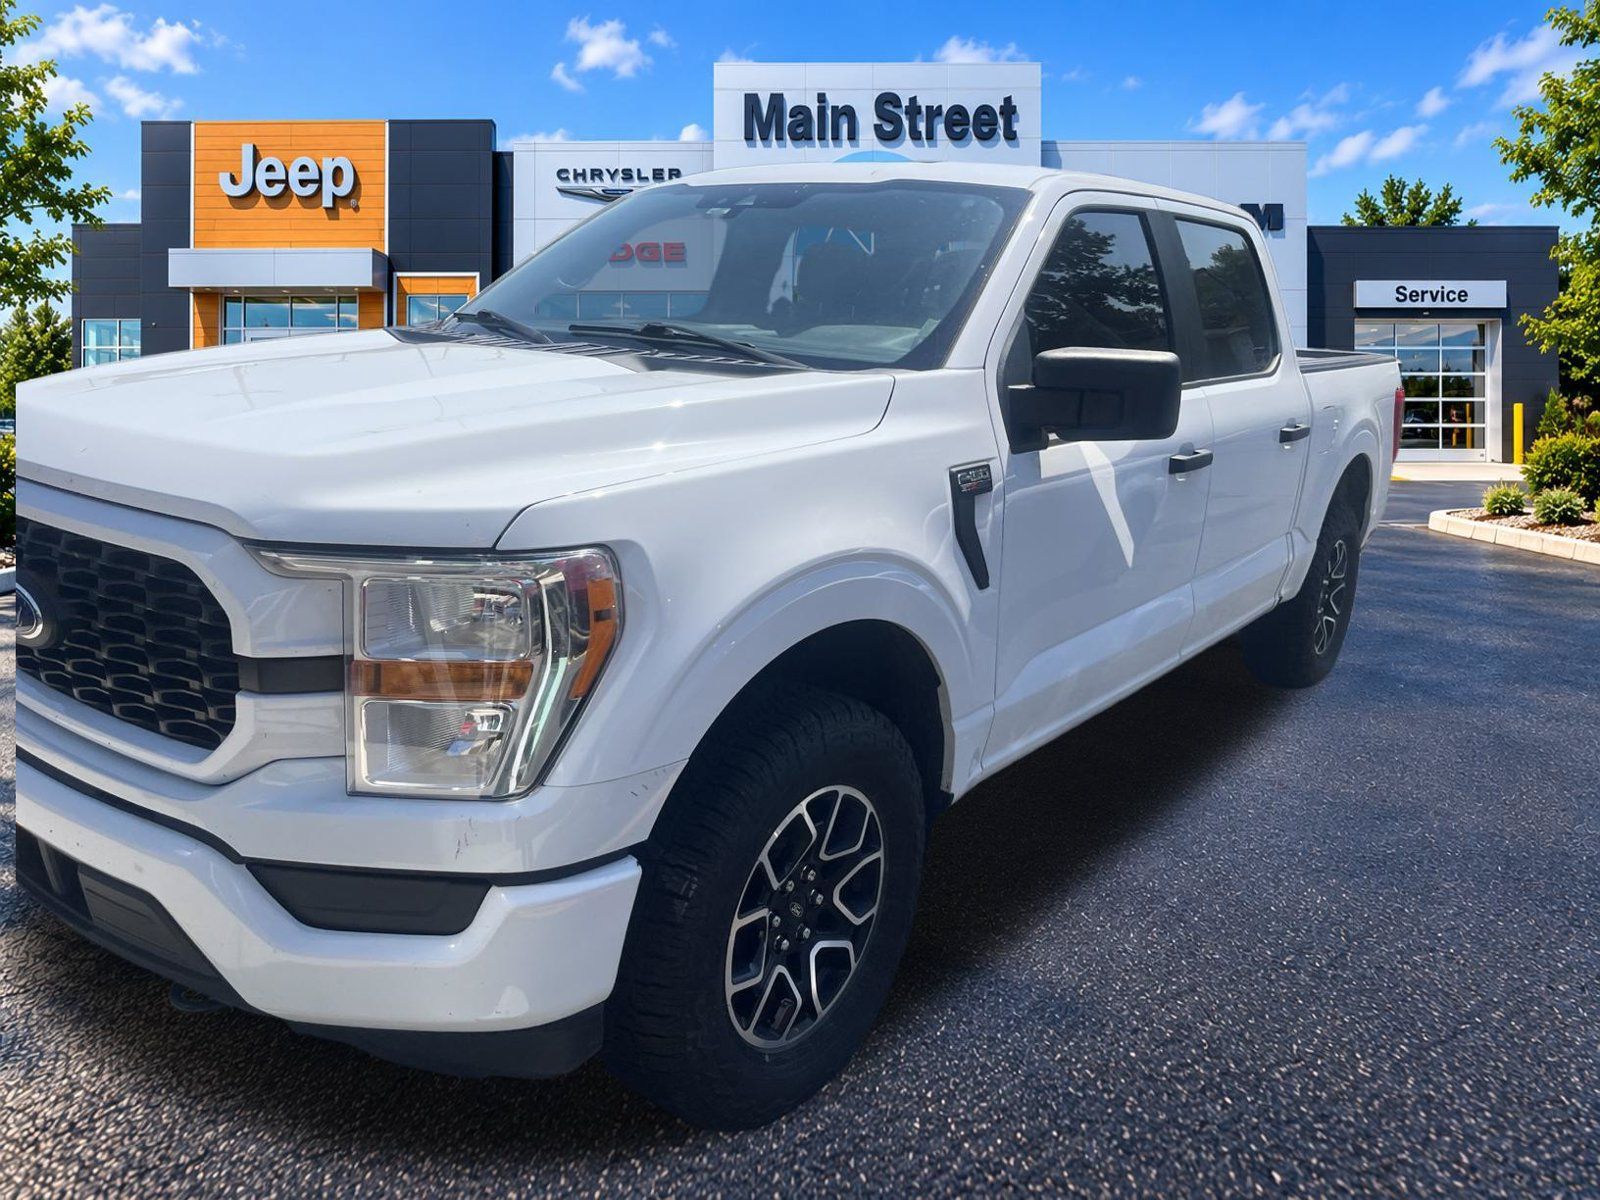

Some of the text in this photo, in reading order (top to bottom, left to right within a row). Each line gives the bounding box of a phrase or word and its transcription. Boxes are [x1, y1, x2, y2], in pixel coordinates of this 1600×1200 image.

[743, 91, 1018, 142] Main Street
[218, 143, 355, 209] Jeep
[556, 168, 682, 183] CHRYSLER
[1395, 285, 1469, 303] Service
